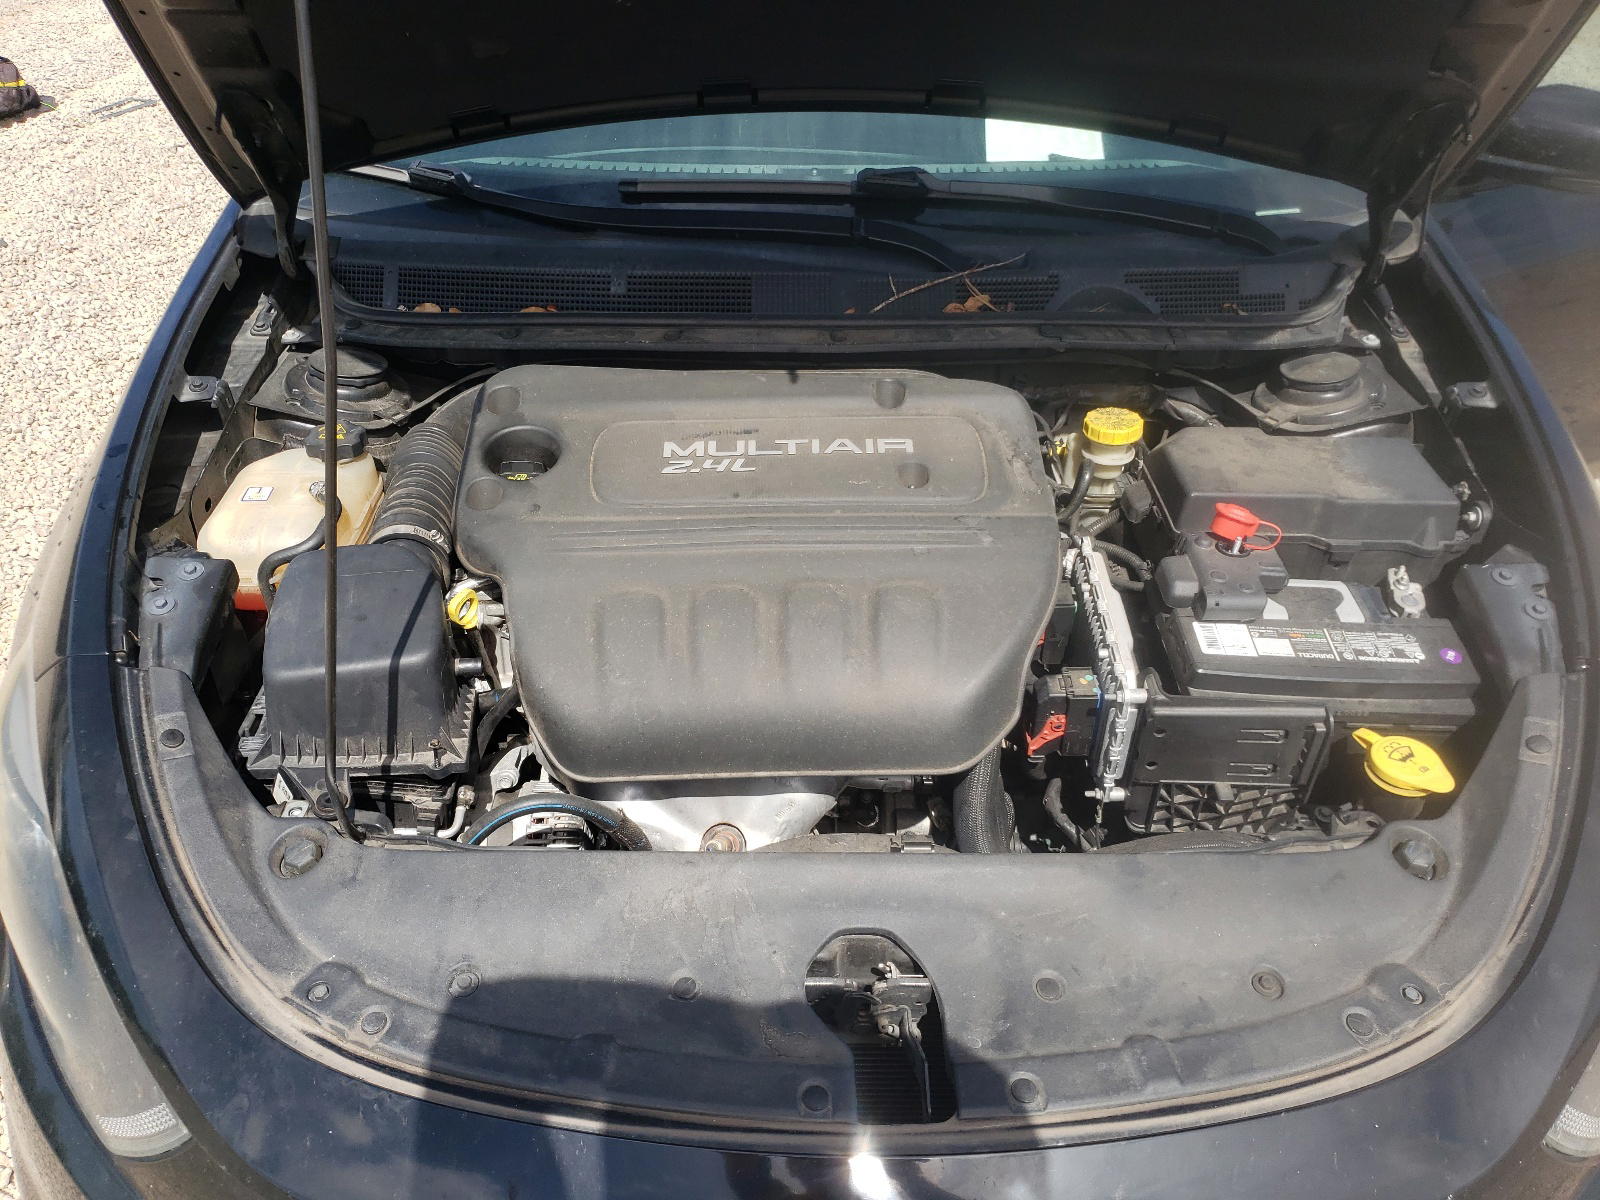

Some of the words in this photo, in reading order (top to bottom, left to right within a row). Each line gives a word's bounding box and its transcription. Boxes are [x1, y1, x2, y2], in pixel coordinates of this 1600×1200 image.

[662, 438, 914, 458] MULTIAIR
[660, 457, 756, 474] 2.4L
[1297, 652, 1335, 660] DURACELL
